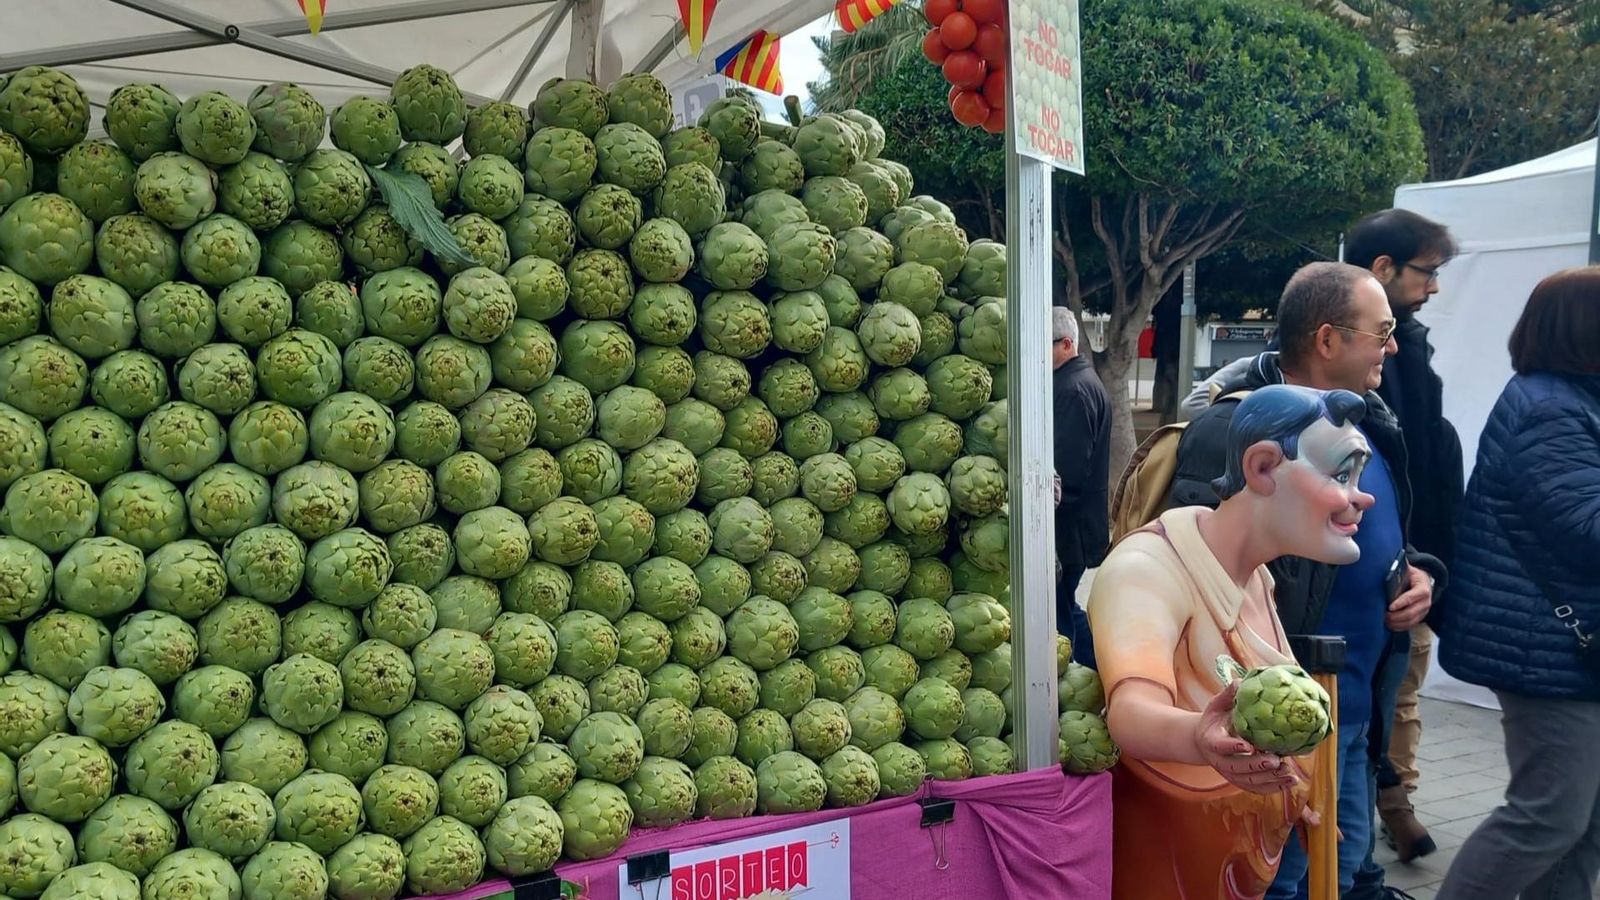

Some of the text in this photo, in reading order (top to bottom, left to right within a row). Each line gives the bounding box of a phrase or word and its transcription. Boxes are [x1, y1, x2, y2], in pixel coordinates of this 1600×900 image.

[1037, 19, 1058, 48] NO
[1024, 37, 1071, 80] TOCAR
[1041, 104, 1060, 133] NO
[1028, 124, 1074, 162] TOCAR
[675, 853, 801, 900] SORTEO
